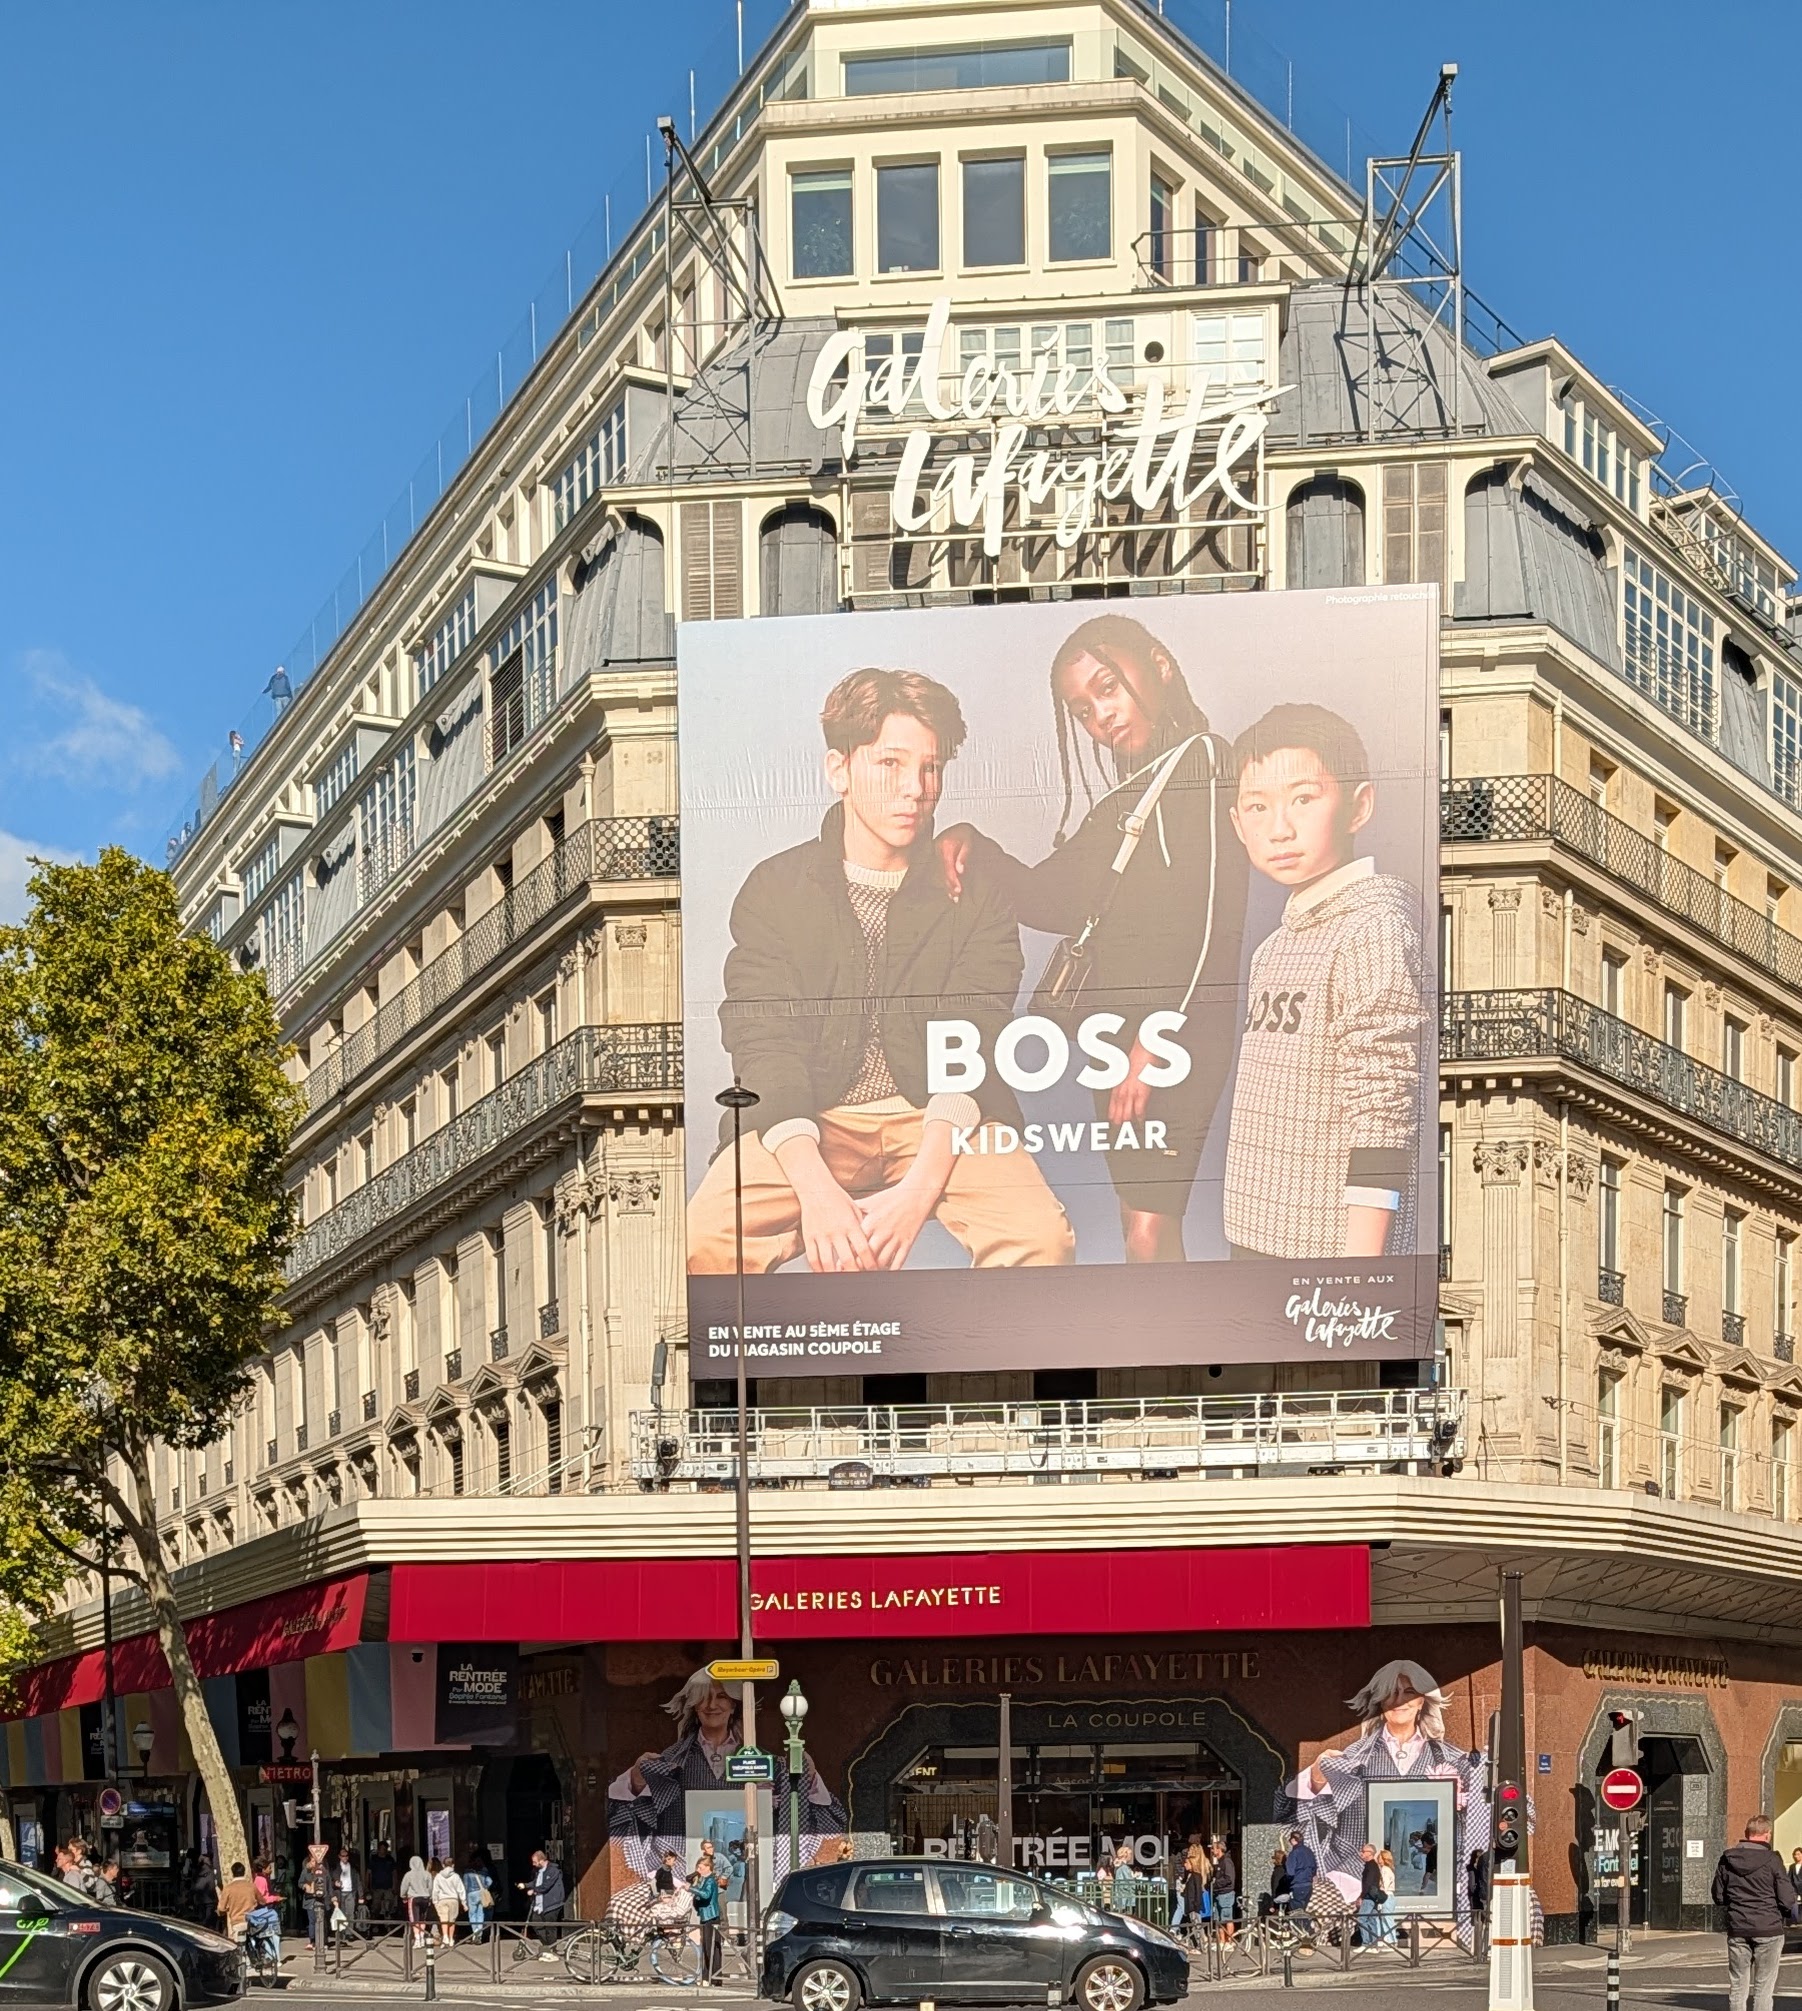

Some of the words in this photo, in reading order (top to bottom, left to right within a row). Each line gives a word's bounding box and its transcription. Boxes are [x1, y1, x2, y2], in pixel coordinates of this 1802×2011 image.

[806, 296, 1127, 460] Galeries
[893, 371, 1298, 558] Lafayette
[1325, 593, 1388, 605] Photographie
[926, 1010, 1192, 1094] BOSS
[951, 1120, 1168, 1155] KIDSWEAR
[1317, 1276, 1361, 1284] VENTE
[1367, 1275, 1394, 1283] AUX
[1285, 1287, 1362, 1325] Galeries
[708, 1327, 729, 1339] EN
[785, 1325, 806, 1338] AU
[809, 1322, 850, 1337] 5ÈME
[852, 1321, 901, 1336] ÉTAGE
[1305, 1306, 1401, 1348] Lafayette
[708, 1345, 731, 1357] DU
[807, 1341, 882, 1355] COUPOLE
[750, 1591, 862, 1611] GALERIES
[871, 1586, 1001, 1609] LAFAYETTE
[449, 1669, 508, 1682] RENTRÉE
[460, 1663, 474, 1671] LA
[870, 1655, 1045, 1687] GALERIES
[1056, 1651, 1262, 1683] LAFAYETTE
[464, 1682, 502, 1693] MODE
[1048, 1713, 1077, 1727] LA
[1088, 1711, 1206, 1727] COUPOLE
